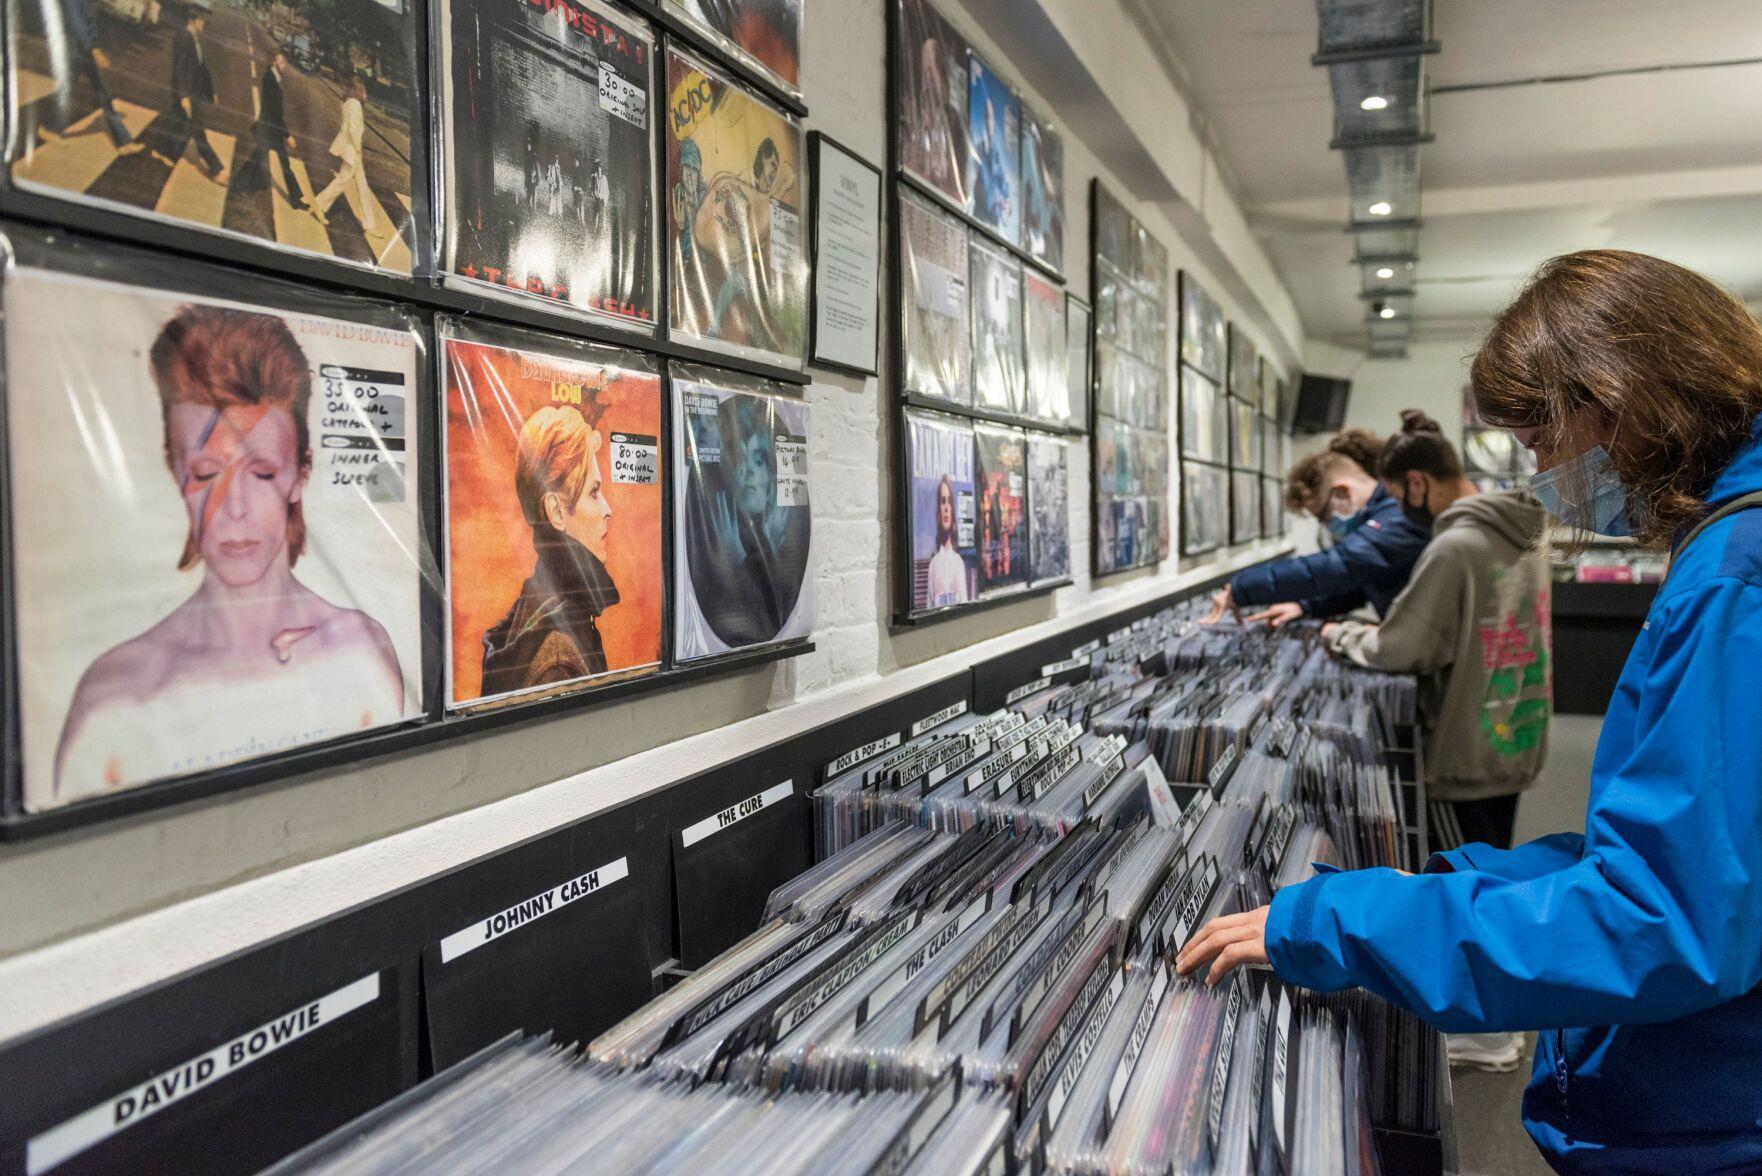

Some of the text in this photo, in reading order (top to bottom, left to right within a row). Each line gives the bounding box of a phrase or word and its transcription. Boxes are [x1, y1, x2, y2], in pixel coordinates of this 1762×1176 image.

[550, 380, 582, 405] LOW
[615, 460, 654, 474] ORIGINAL
[835, 752, 853, 772] ROCK
[855, 750, 860, 761] &
[862, 743, 876, 759] POP
[902, 761, 924, 785] ELECTRIC
[924, 752, 940, 771] LIGHT
[945, 749, 975, 775] BRIAN ENO
[981, 751, 1013, 780] ERASURE
[1010, 750, 1039, 782] EURYTHMICS
[1040, 776, 1052, 792] ROCK
[717, 794, 763, 828] THE CURE
[485, 871, 599, 939] JOHNNY CASH
[1183, 874, 1210, 932] BOB DYLAN
[906, 918, 960, 981] THE CLASH
[965, 906, 1039, 1000] LEONARD COHEN
[1056, 921, 1086, 973] COODER
[790, 992, 820, 1028] ERIC
[1061, 987, 1113, 1097] ELVIS COSTELLO
[1124, 992, 1155, 1076] THE CRAMPS
[114, 1002, 320, 1126] DAVID BOWIE
